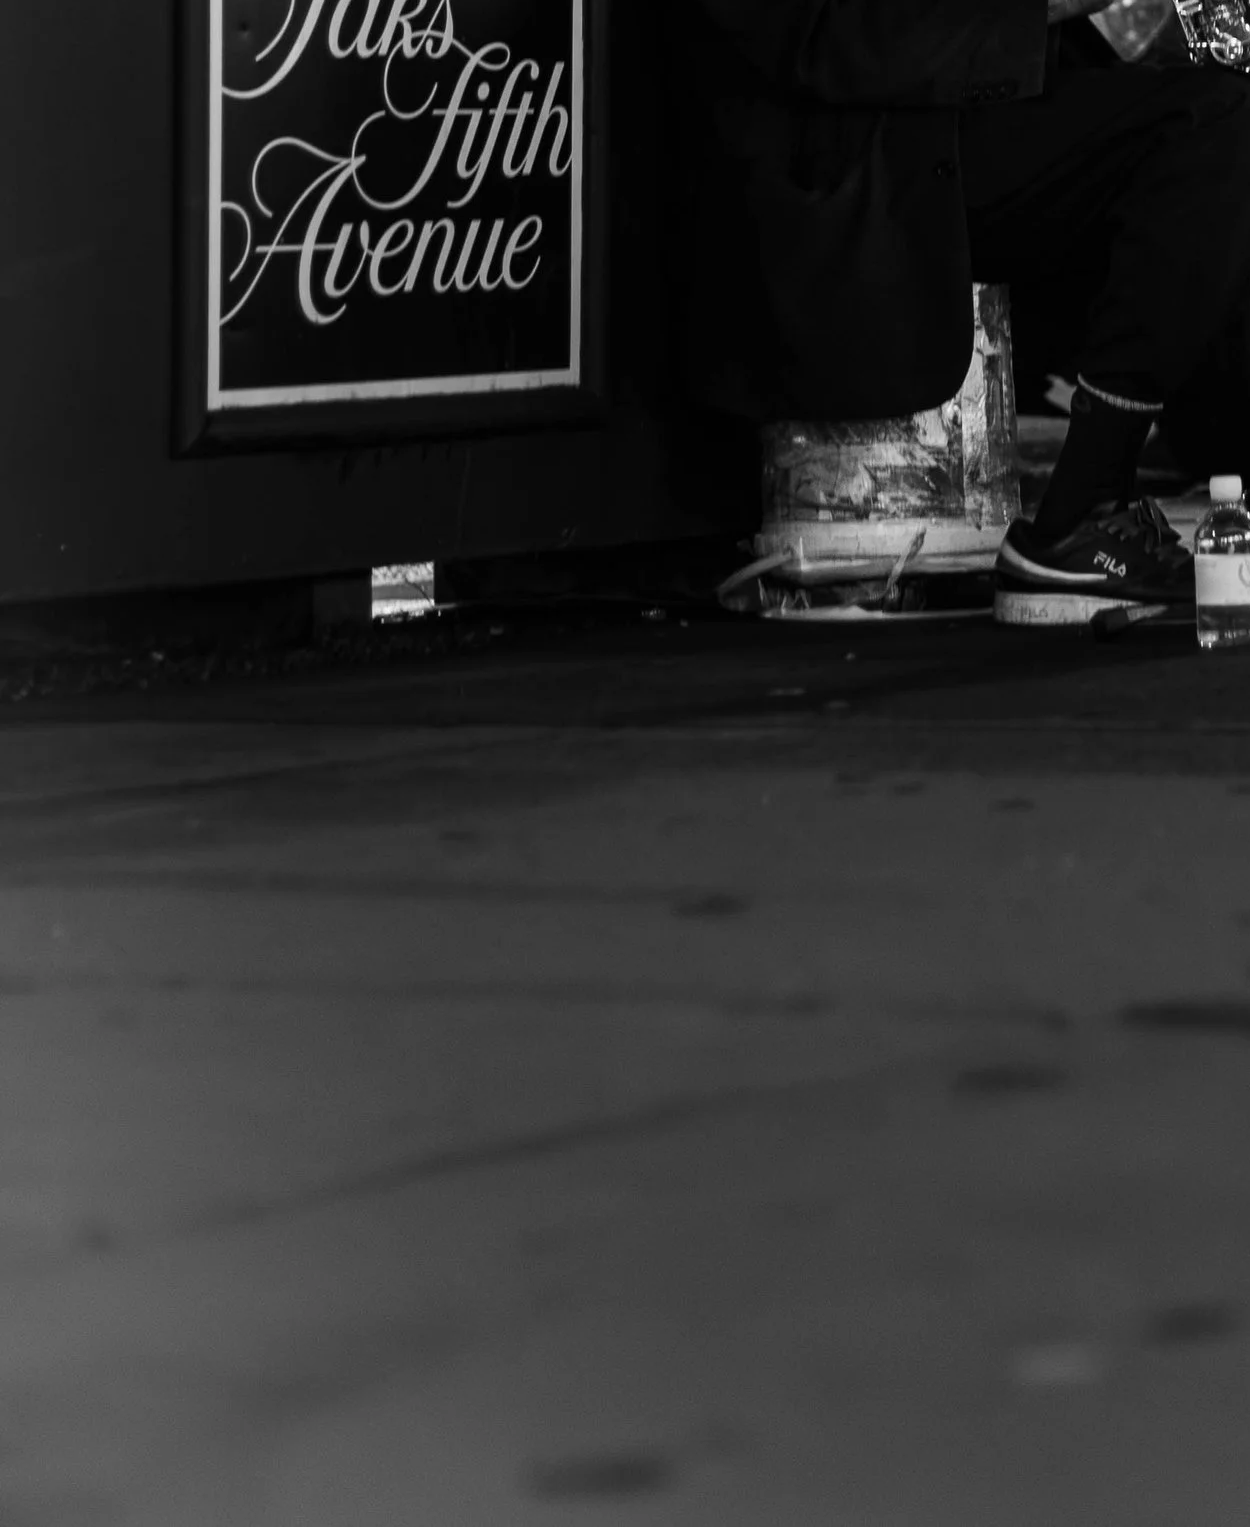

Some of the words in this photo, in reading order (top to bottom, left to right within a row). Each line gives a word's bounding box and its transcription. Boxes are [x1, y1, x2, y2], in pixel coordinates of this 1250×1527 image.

[352, 30, 572, 209] Fifth
[219, 136, 543, 326] Avenue
[1093, 551, 1127, 578] FILA
